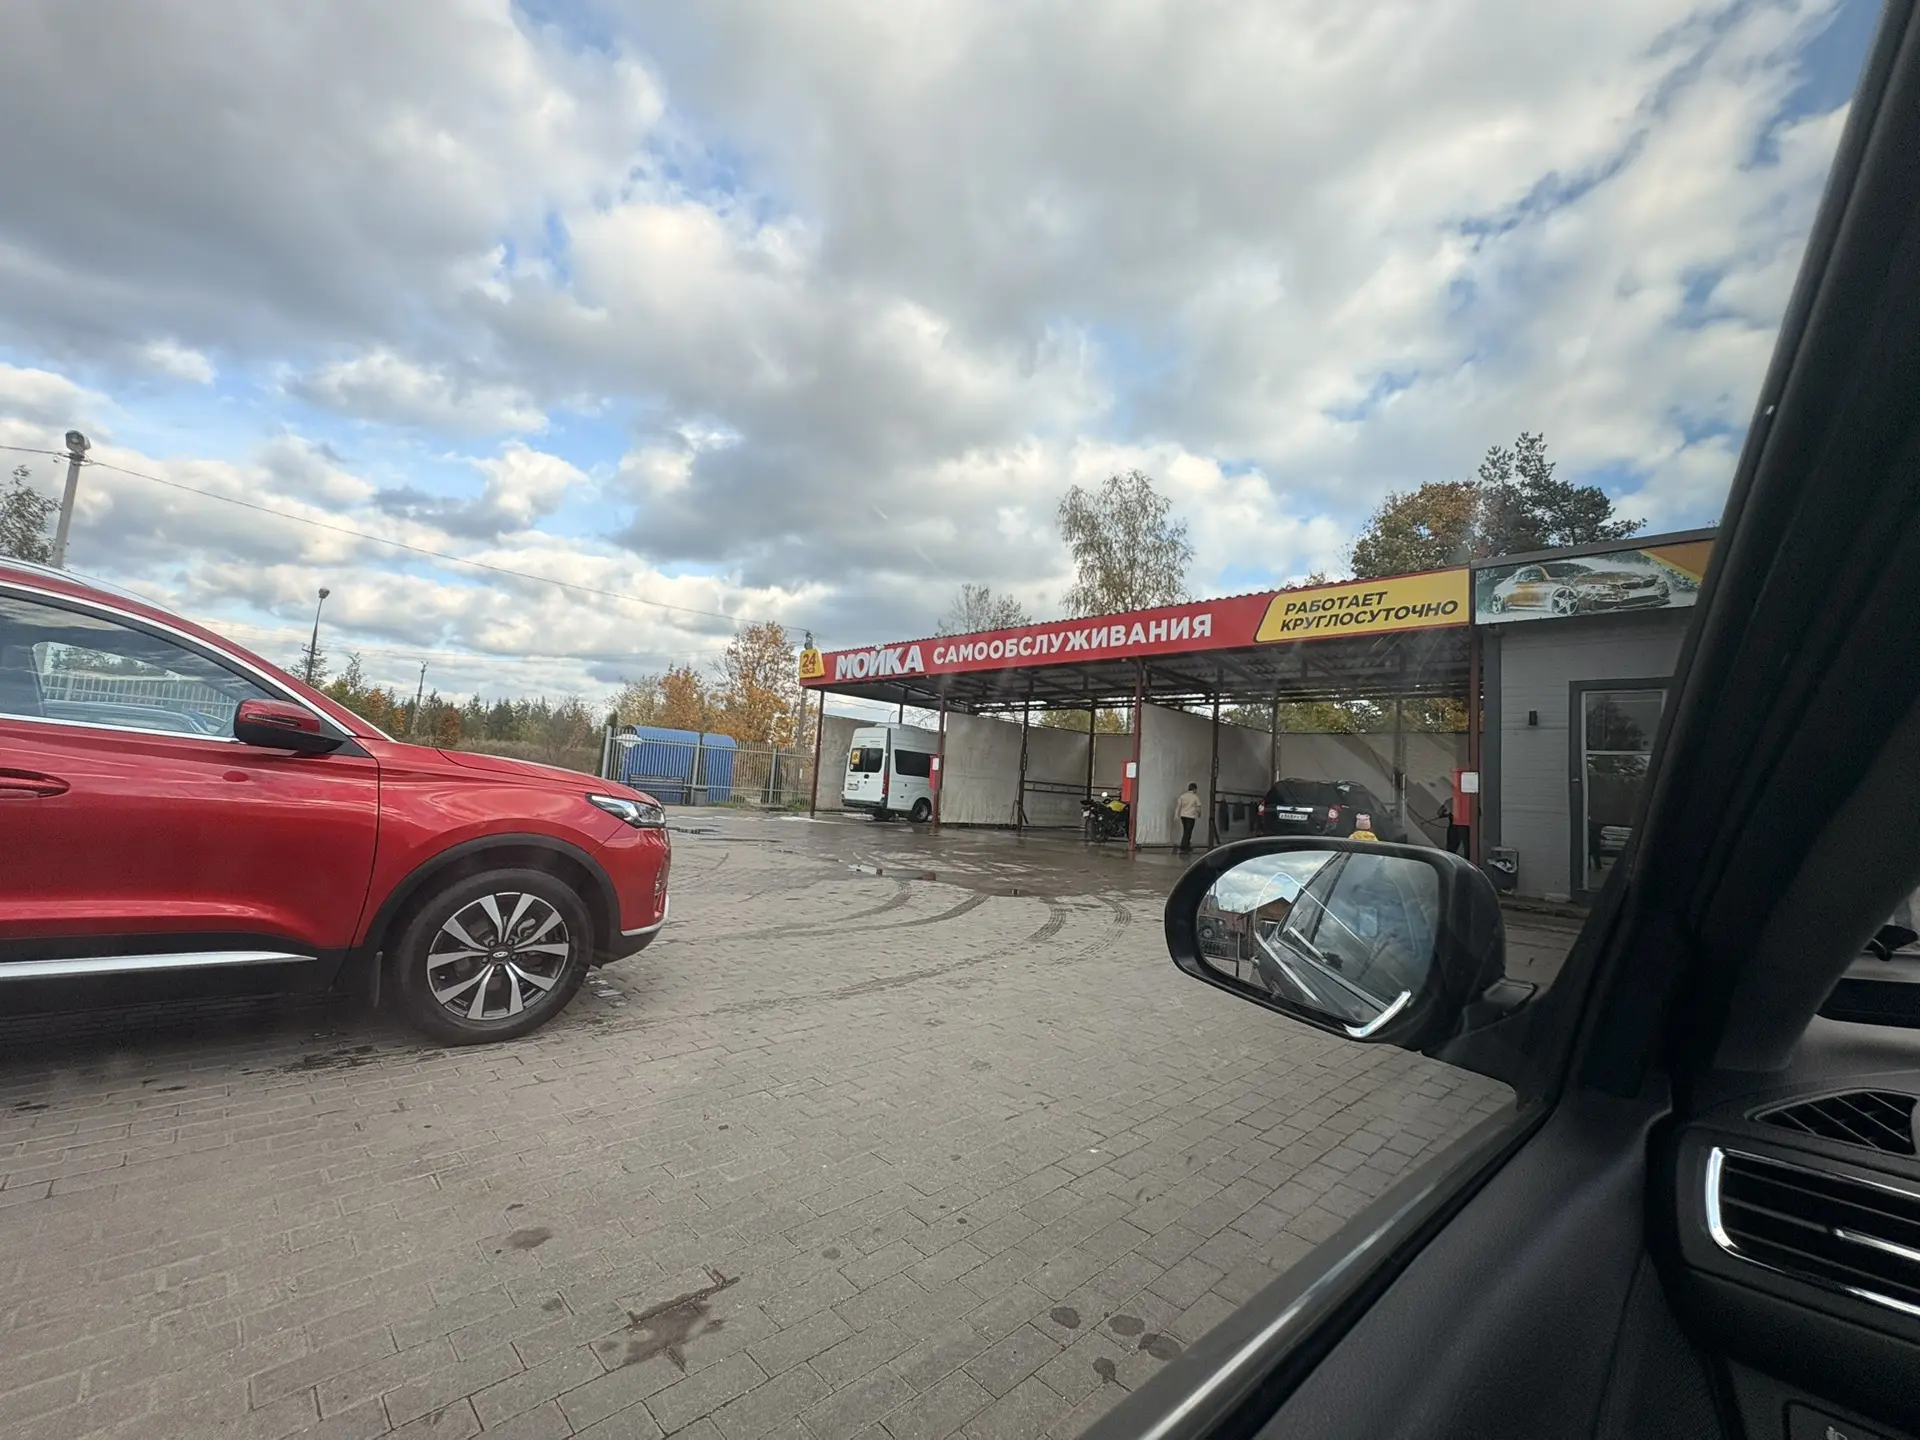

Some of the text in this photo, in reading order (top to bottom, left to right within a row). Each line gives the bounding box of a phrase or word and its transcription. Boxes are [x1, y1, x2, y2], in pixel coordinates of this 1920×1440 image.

[1280, 600, 1459, 632] КРУГЛОСУТОЧНО
[1285, 591, 1388, 616] РАБОТАЕТ
[802, 653, 817, 668] 24
[835, 613, 1212, 680] МОЙКА САМООБСЛУЖИВАНИЯ
